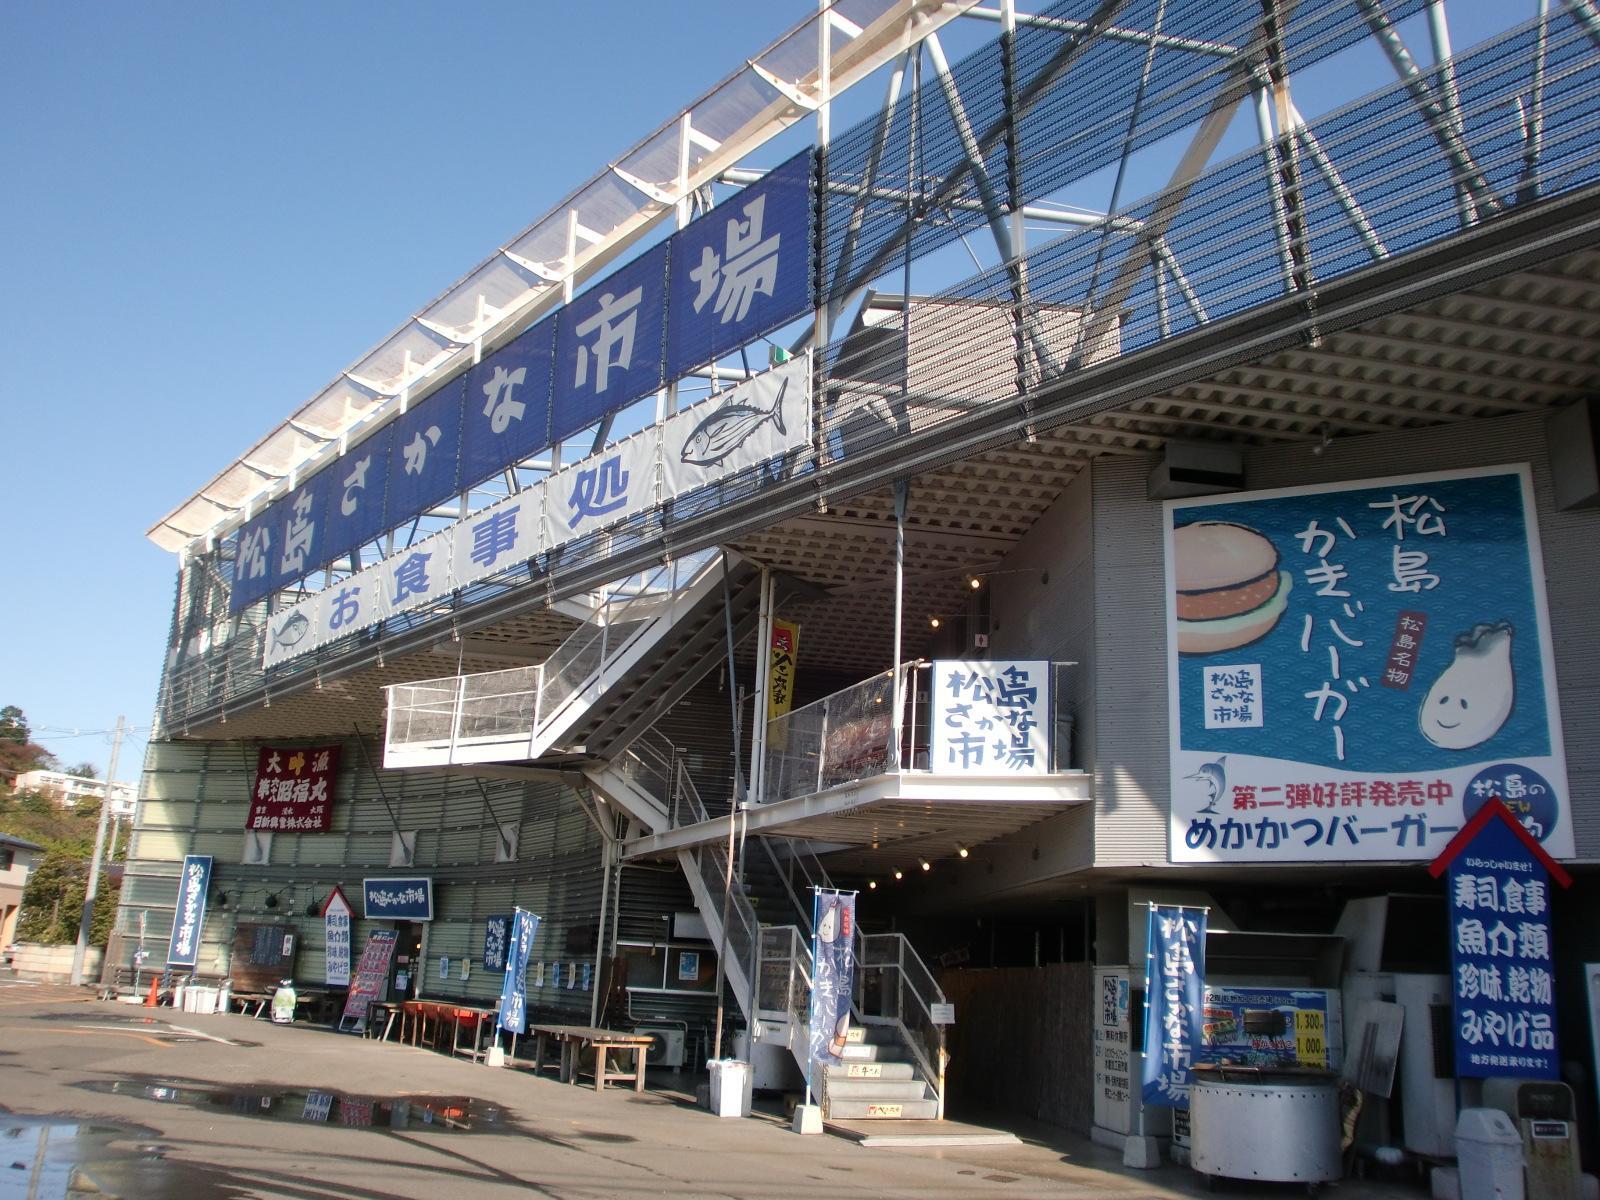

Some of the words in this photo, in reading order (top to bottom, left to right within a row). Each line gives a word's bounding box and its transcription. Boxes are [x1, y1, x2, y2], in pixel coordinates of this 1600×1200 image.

[235, 194, 781, 580] 松島さかな市場
[329, 455, 630, 630] お食事処
[1369, 494, 1446, 593] 松島
[1295, 517, 1369, 761] かきバーガー
[1386, 616, 1423, 685] 松島名物
[946, 665, 1038, 710] 松島
[1211, 670, 1253, 690] 松島
[1211, 687, 1254, 704] さかな
[945, 703, 1037, 731] さかな
[1214, 705, 1253, 723] 市場
[947, 732, 1035, 770] 市場
[1232, 780, 1453, 810] 第二弾好評発売中
[1472, 774, 1545, 798] 松島の
[1185, 814, 1458, 850] めかかつバーガー
[176, 864, 204, 957] 松島さかな市場
[369, 888, 425, 908] 松島さかな市場
[1457, 918, 1550, 960] 魚介類
[1462, 1009, 1554, 1051] みやげ品
